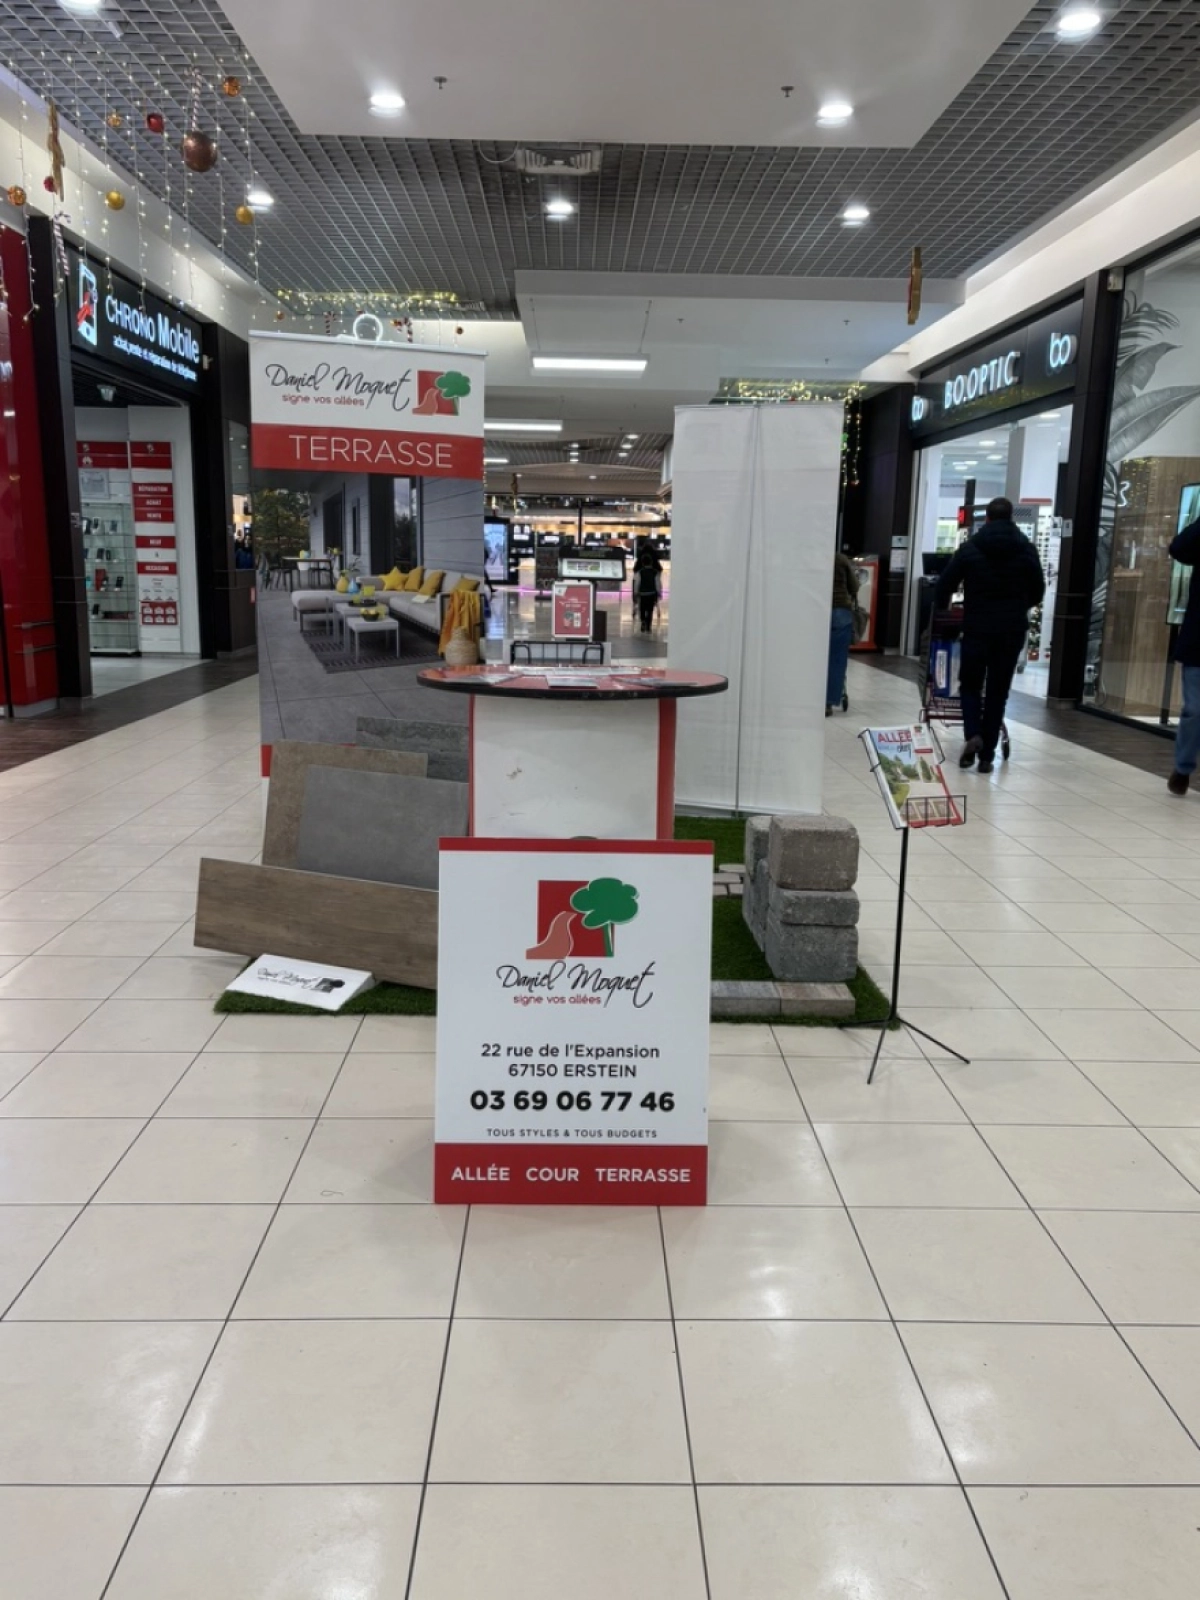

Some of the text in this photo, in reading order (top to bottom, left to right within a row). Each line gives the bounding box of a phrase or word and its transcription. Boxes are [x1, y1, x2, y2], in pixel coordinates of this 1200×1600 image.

[105, 295, 200, 363] CHRONO Mobile
[1050, 332, 1077, 368] bo
[265, 362, 412, 411] Daniel Moquet
[944, 351, 1021, 409] BO.OPTIC
[282, 393, 365, 406] signe vos allées
[288, 434, 453, 468] TERRASSE
[496, 960, 656, 1008] Daniel Moquet
[514, 994, 602, 1006] signe vos allées
[481, 1043, 660, 1060] 22 rue de l'Expansion
[508, 1064, 637, 1077] 67150 ERSTEIN
[470, 1090, 675, 1112] 03 69 06 77 46
[487, 1128, 658, 1138] TOUS STYLES & TOUS BUDGETS
[451, 1163, 691, 1183] ALLÉE COUR TERRASSE
